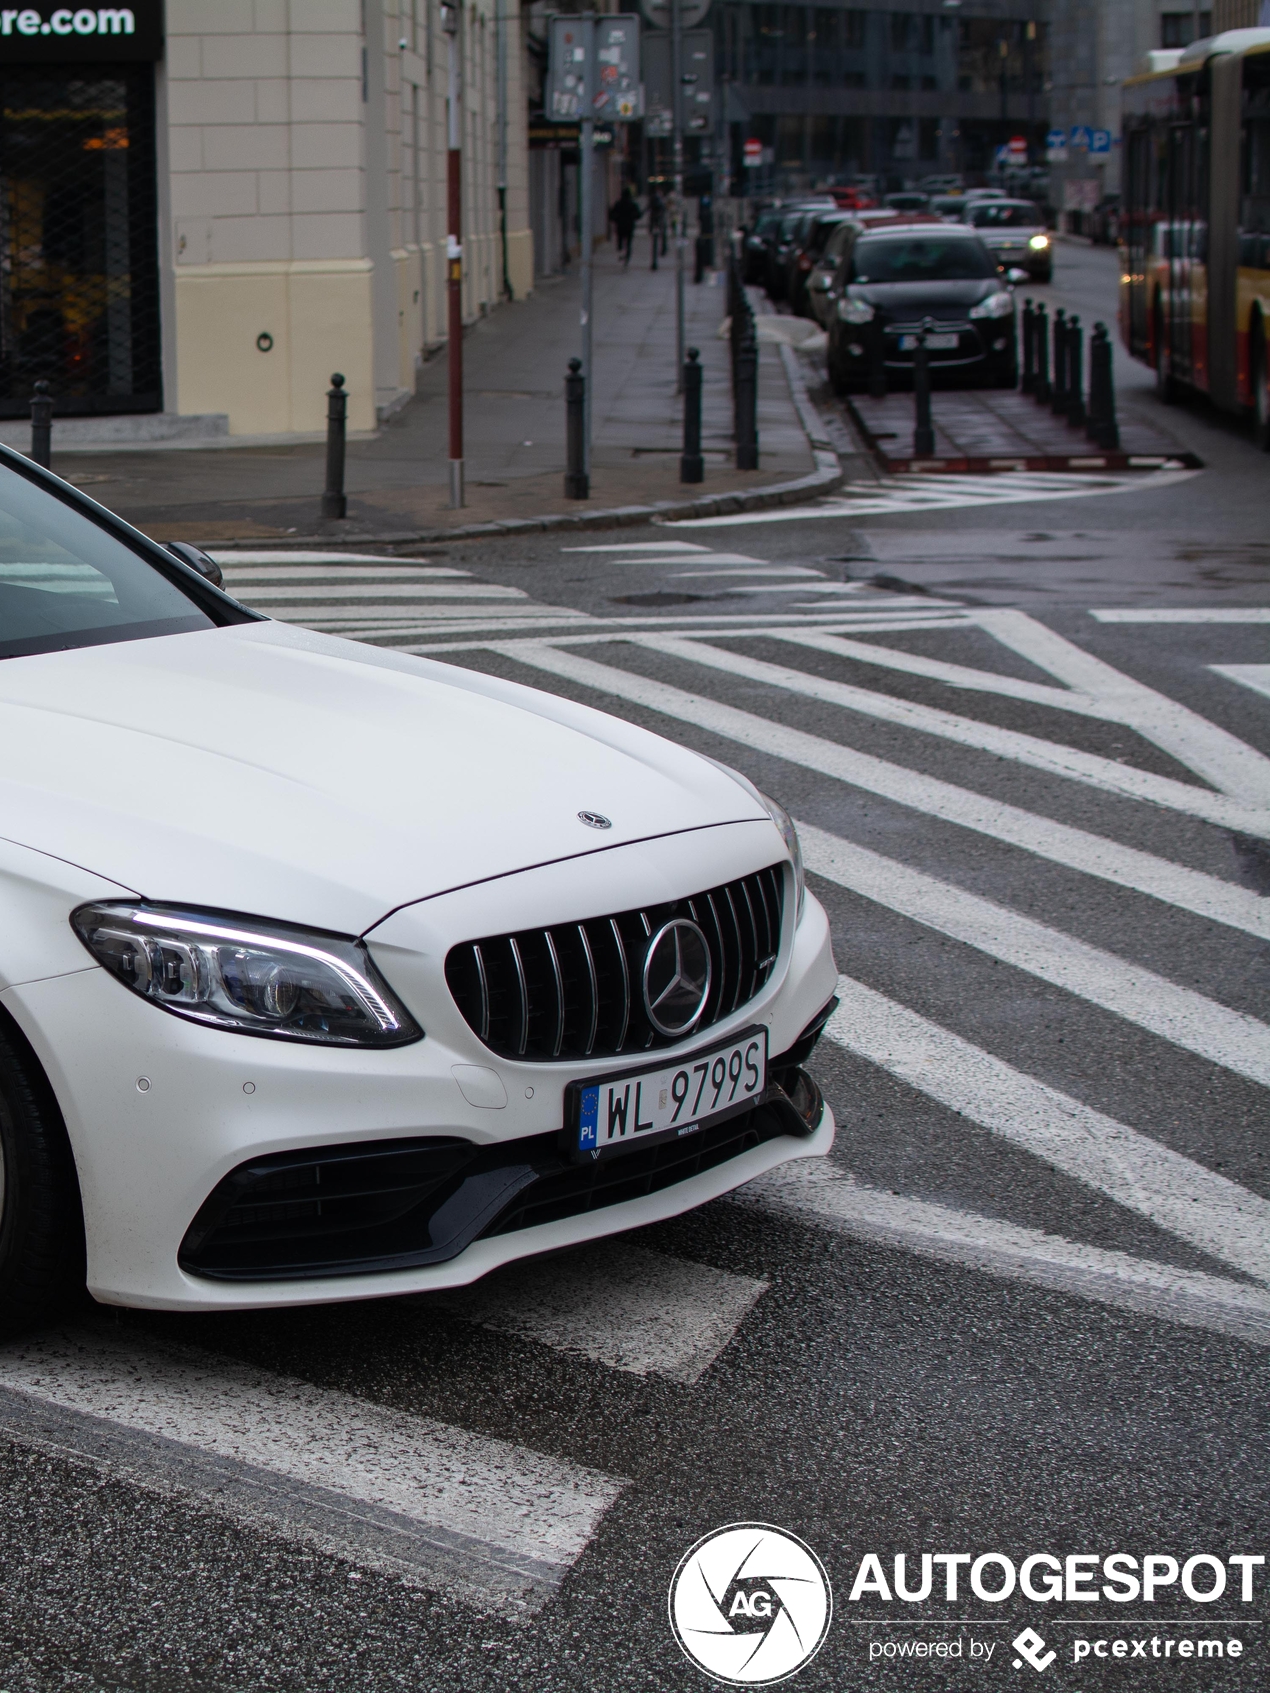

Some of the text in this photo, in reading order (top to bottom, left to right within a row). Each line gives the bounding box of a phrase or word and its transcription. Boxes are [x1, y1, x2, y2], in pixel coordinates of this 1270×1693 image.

[607, 1041, 760, 1139] WL 9799S
[580, 1126, 594, 1141] PL
